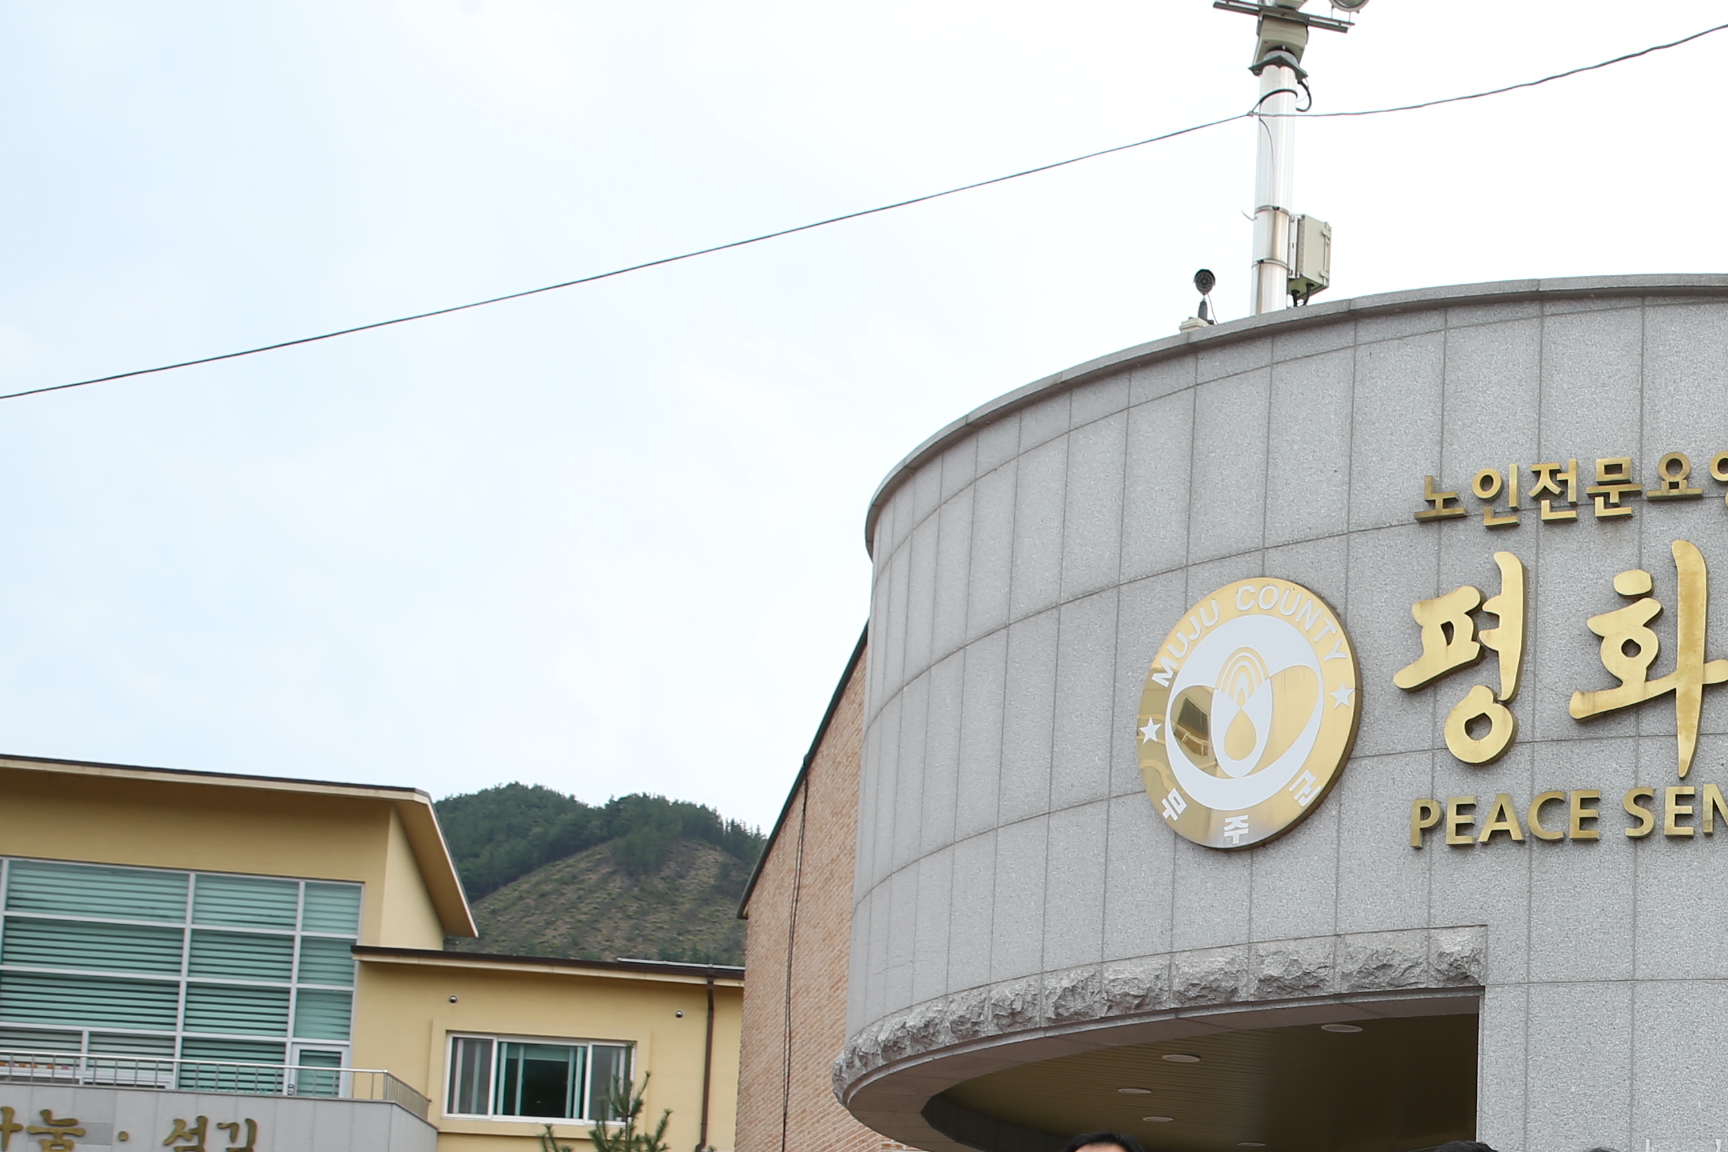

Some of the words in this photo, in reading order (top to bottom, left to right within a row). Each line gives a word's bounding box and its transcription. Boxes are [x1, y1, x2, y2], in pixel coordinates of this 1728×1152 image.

[1151, 599, 1220, 688] MUJU
[1236, 584, 1347, 662] COUNTY
[1161, 769, 1323, 845] 무주군
[1409, 790, 1600, 849] PEACE
